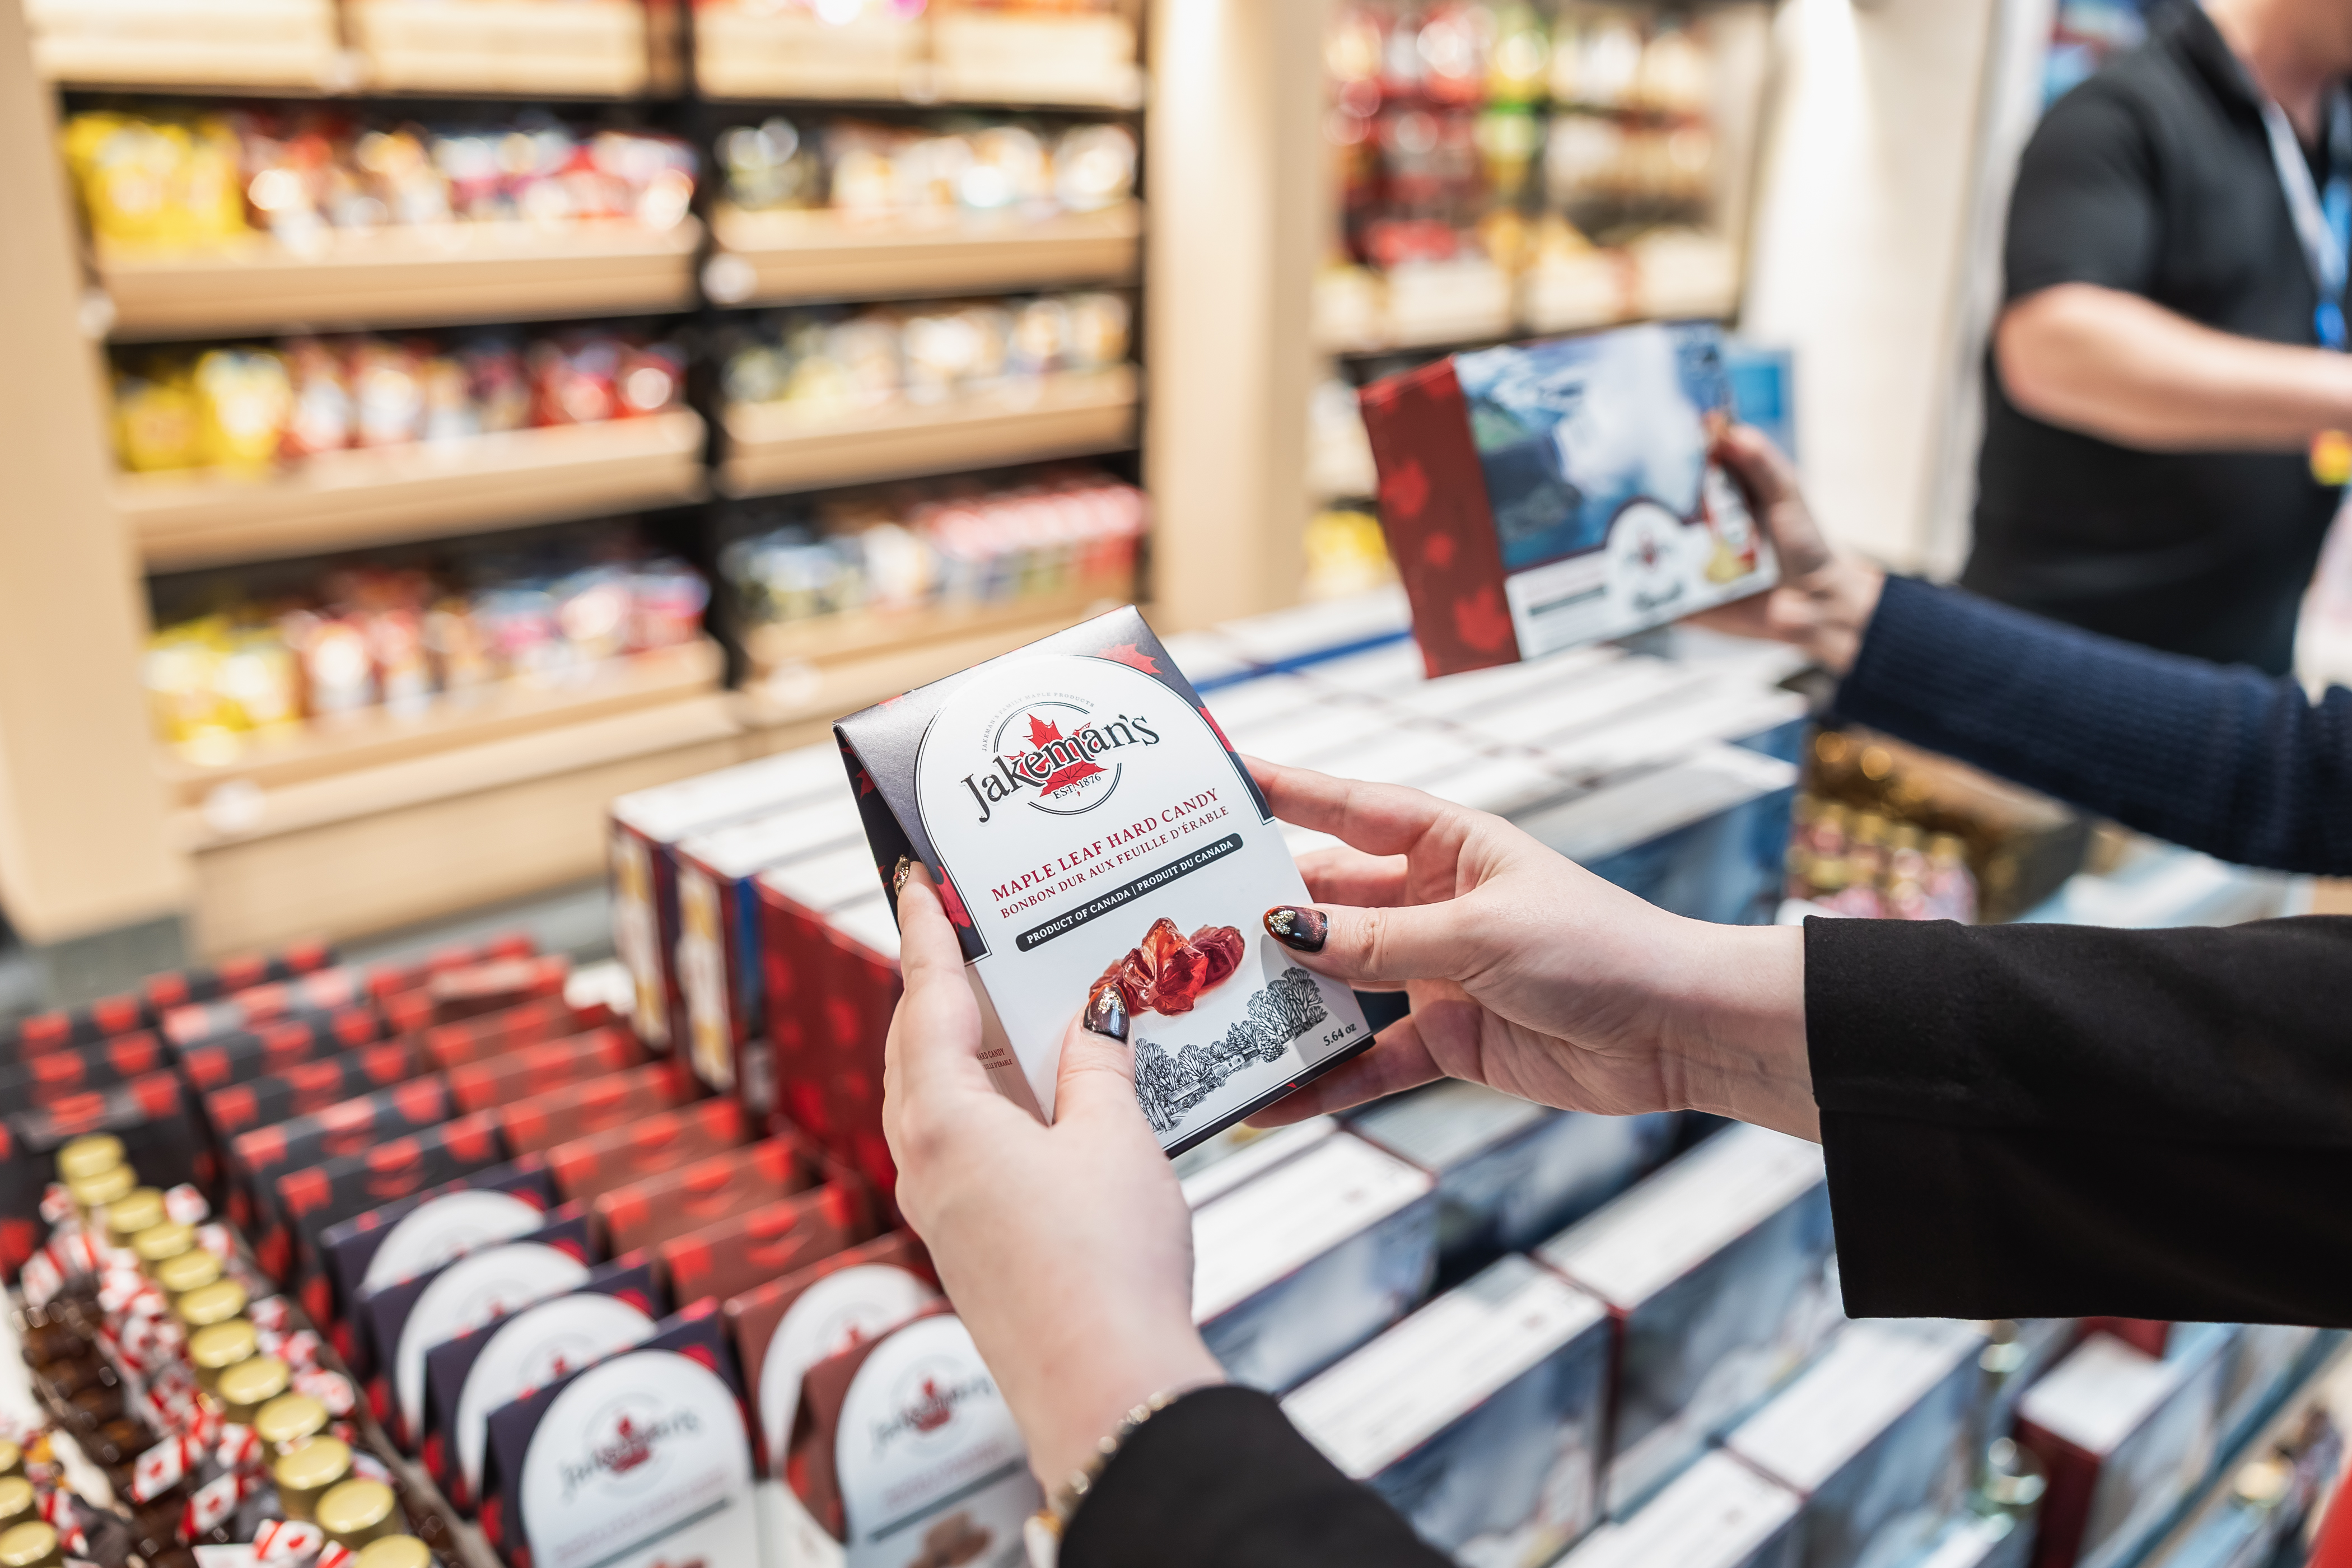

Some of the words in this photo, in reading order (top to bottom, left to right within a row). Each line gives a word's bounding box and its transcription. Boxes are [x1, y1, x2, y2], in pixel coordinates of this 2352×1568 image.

[999, 697, 1023, 715] FAMILY
[1054, 692, 1095, 707] PRODUCTS
[960, 714, 1160, 823] Jakeman's
[1080, 773, 1102, 788] 1876
[991, 864, 1056, 902] MAPLE
[1057, 841, 1102, 871] LEAF
[1106, 817, 1157, 848] HARD
[1161, 788, 1218, 823] CANDY
[1000, 886, 1056, 919] BONBON
[1057, 873, 1086, 892] DUR
[1089, 859, 1116, 878] AUX
[1116, 834, 1169, 865] FEUILLE
[1169, 806, 1229, 840] D'ÉRABLE
[1026, 916, 1074, 944] PRODUCT
[1075, 908, 1088, 921] OF
[1090, 890, 1131, 914] CANADA
[1137, 866, 1178, 892] PRODUIT
[1179, 858, 1194, 871] DU
[1194, 841, 1234, 863] CANADA
[988, 1048, 1005, 1058] CANDY
[1323, 1028, 1344, 1046] 5.64
[1345, 1023, 1357, 1034] oz
